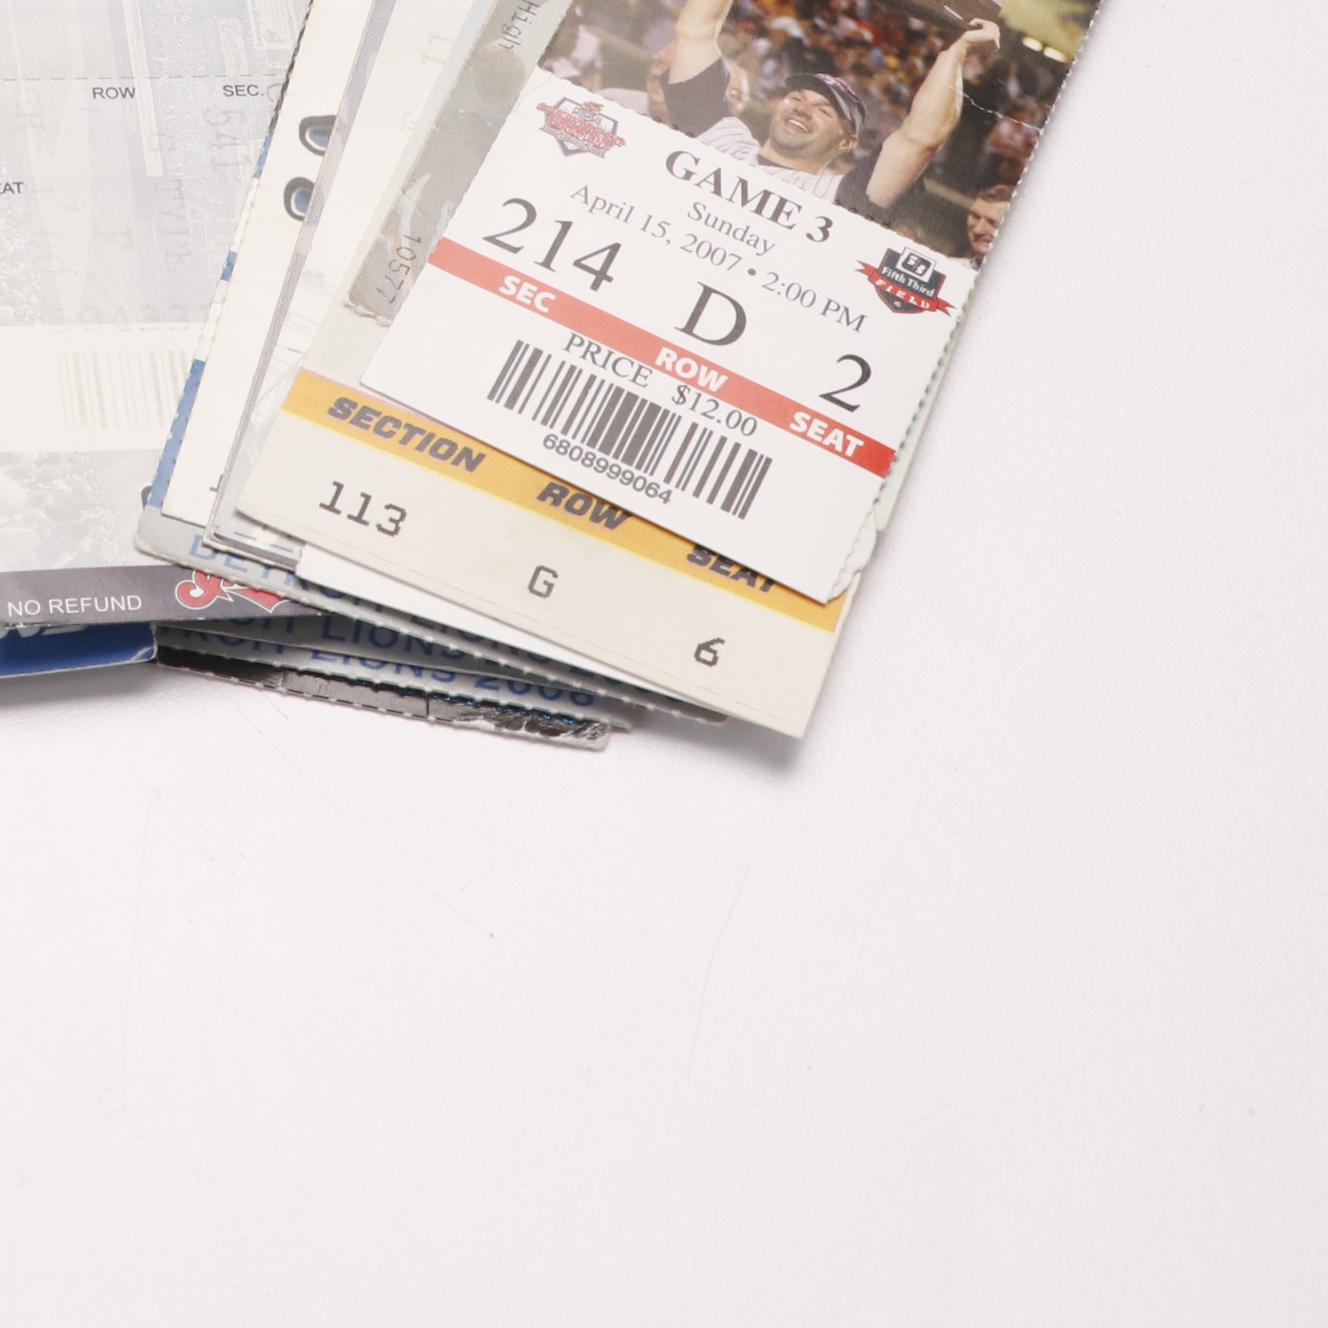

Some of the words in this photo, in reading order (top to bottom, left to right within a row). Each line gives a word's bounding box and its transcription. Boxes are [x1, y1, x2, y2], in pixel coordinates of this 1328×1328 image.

[92, 87, 136, 100] ROW
[222, 84, 264, 98] SEC.
[664, 149, 803, 231] GAME
[806, 216, 835, 246] 3
[686, 200, 778, 256] Sunday
[569, 183, 636, 227] April
[638, 212, 674, 249] 15,
[678, 234, 744, 274] 2007
[761, 270, 819, 310] 2:00
[818, 298, 868, 334] PM
[875, 279, 930, 308] FIELD
[882, 266, 906, 283] Fifth
[907, 278, 935, 297] Third
[481, 196, 623, 293] 214
[673, 280, 749, 348] D
[817, 353, 873, 414] 2
[498, 275, 556, 314] SEC
[653, 347, 730, 394] ROW
[789, 411, 866, 458] SEAT
[560, 331, 654, 391] PRICE
[670, 383, 759, 440] $12.00
[326, 395, 487, 474] SECTION
[535, 479, 632, 532] ROW
[541, 431, 673, 507] 6808999064
[7, 599, 40, 617] NO
[48, 594, 142, 614] REFUND
[318, 479, 408, 538] 113
[526, 564, 560, 600] G
[693, 636, 727, 668] 6
